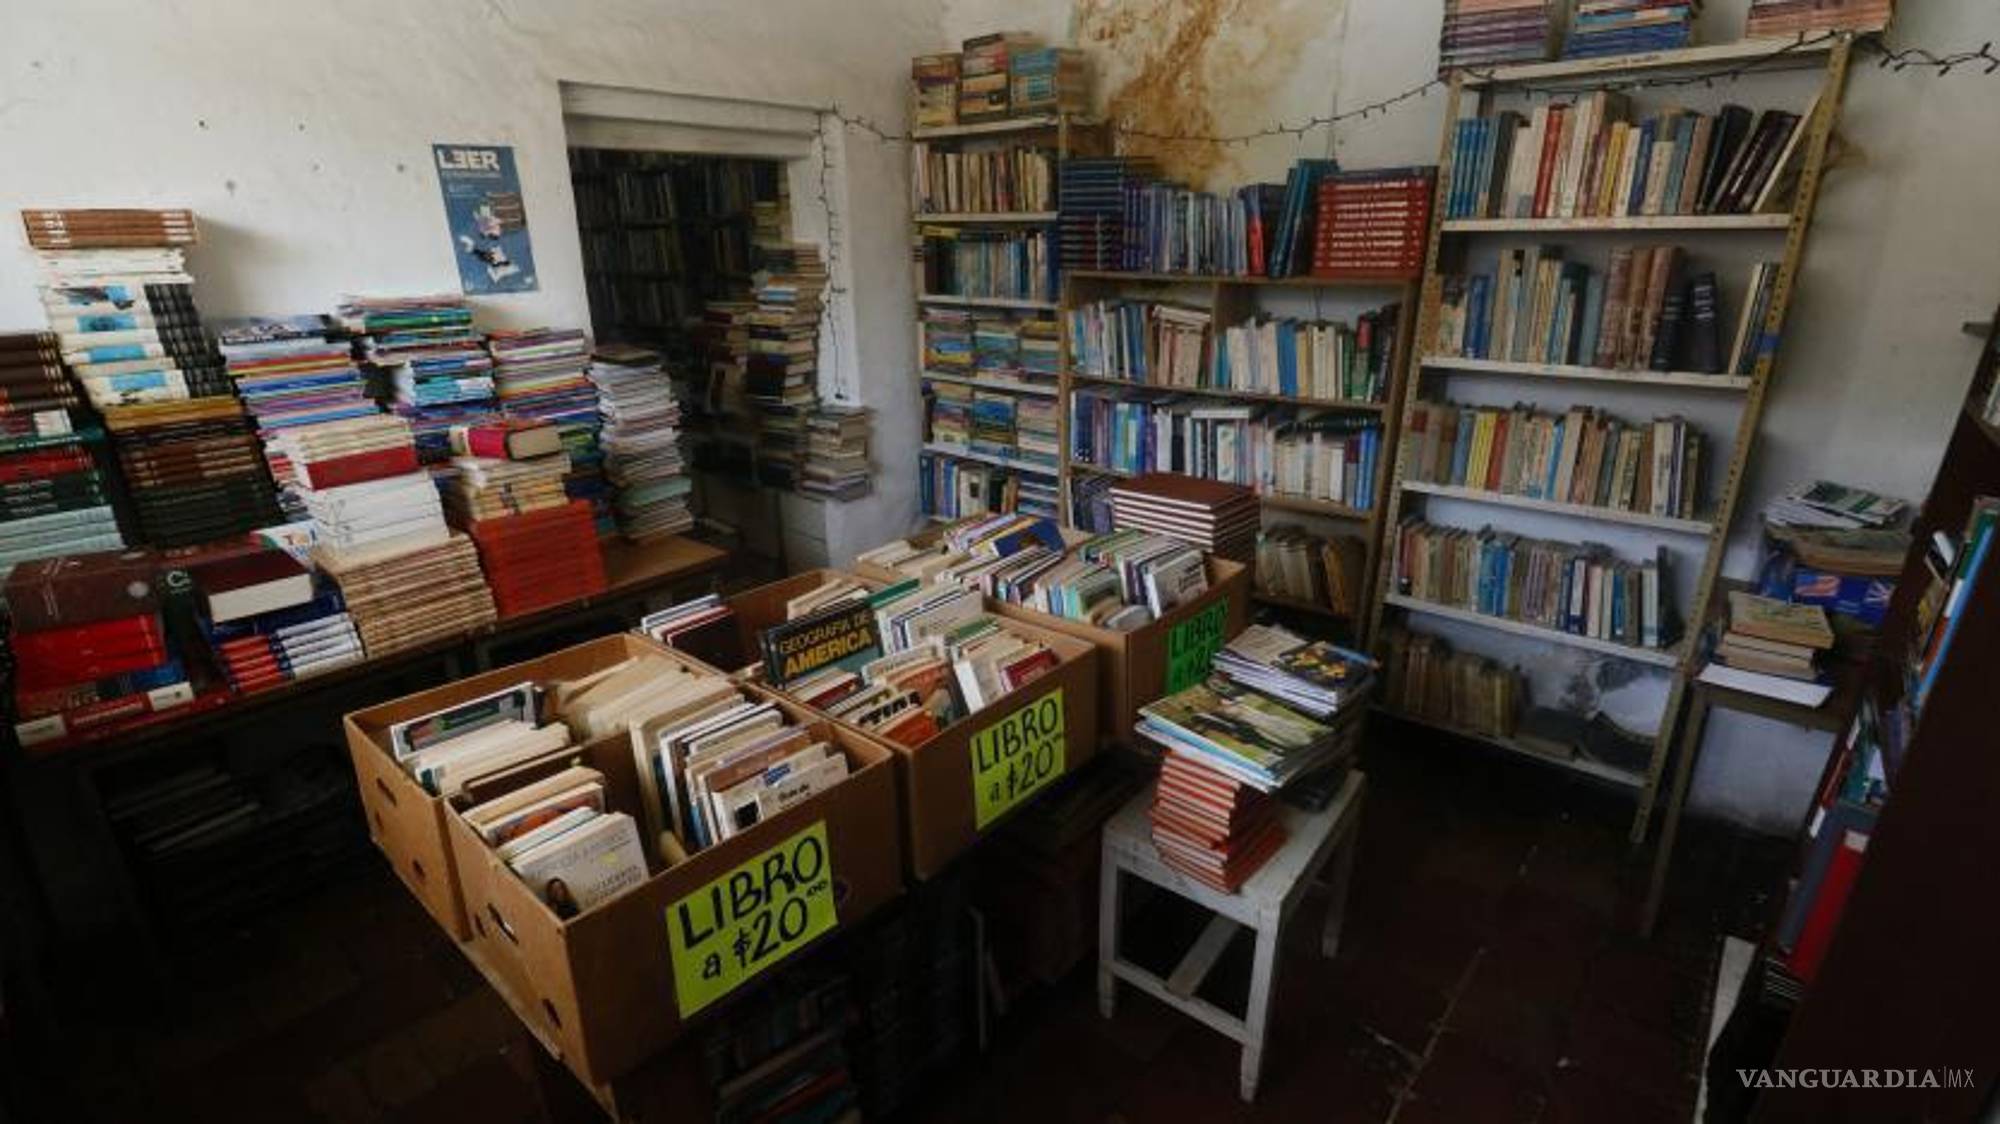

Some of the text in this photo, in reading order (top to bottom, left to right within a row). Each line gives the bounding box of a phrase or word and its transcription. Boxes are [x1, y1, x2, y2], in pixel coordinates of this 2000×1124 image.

[976, 698, 1057, 773] LIBRO
[679, 836, 822, 948] LIBRO
[703, 952, 721, 979] a
